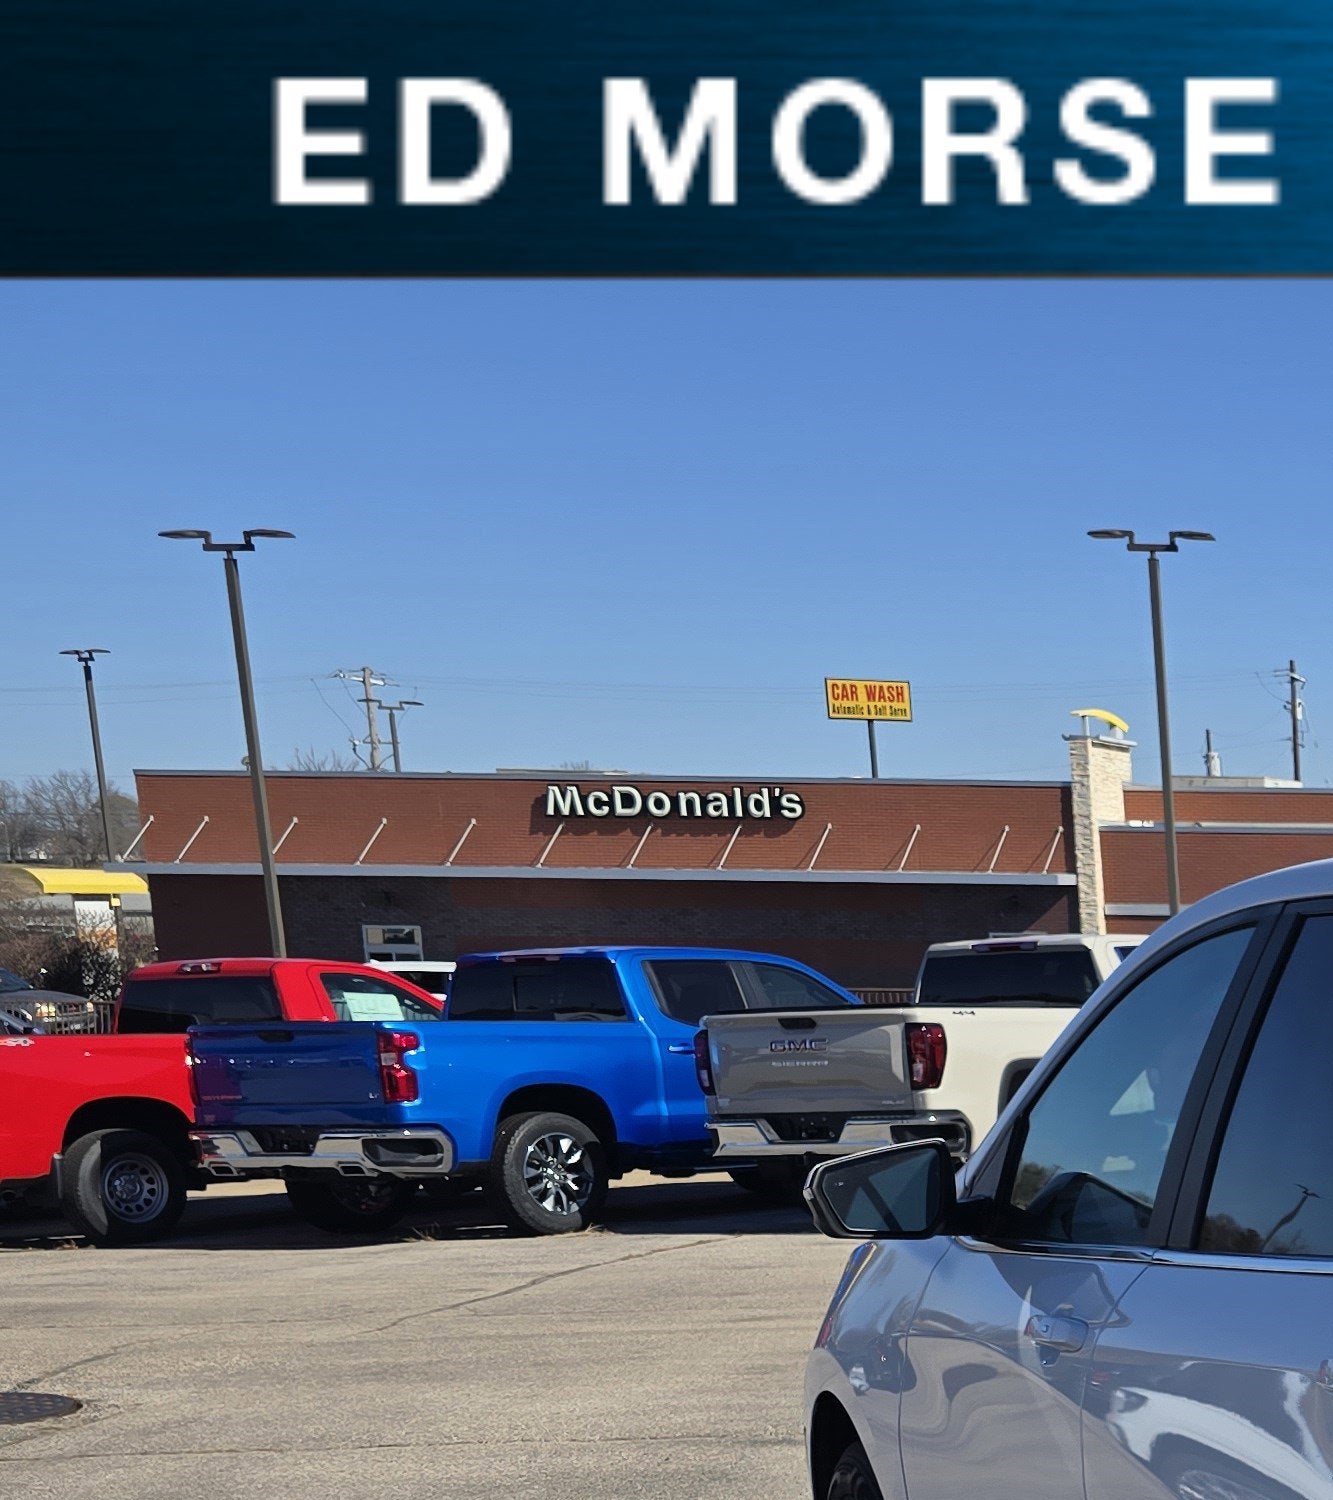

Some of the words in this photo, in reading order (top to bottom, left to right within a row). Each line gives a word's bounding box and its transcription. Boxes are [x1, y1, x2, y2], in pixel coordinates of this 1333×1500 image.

[831, 683, 859, 701] CAR
[864, 684, 904, 702] WASH
[545, 784, 803, 819] McDonald's
[769, 1038, 829, 1053] GMC
